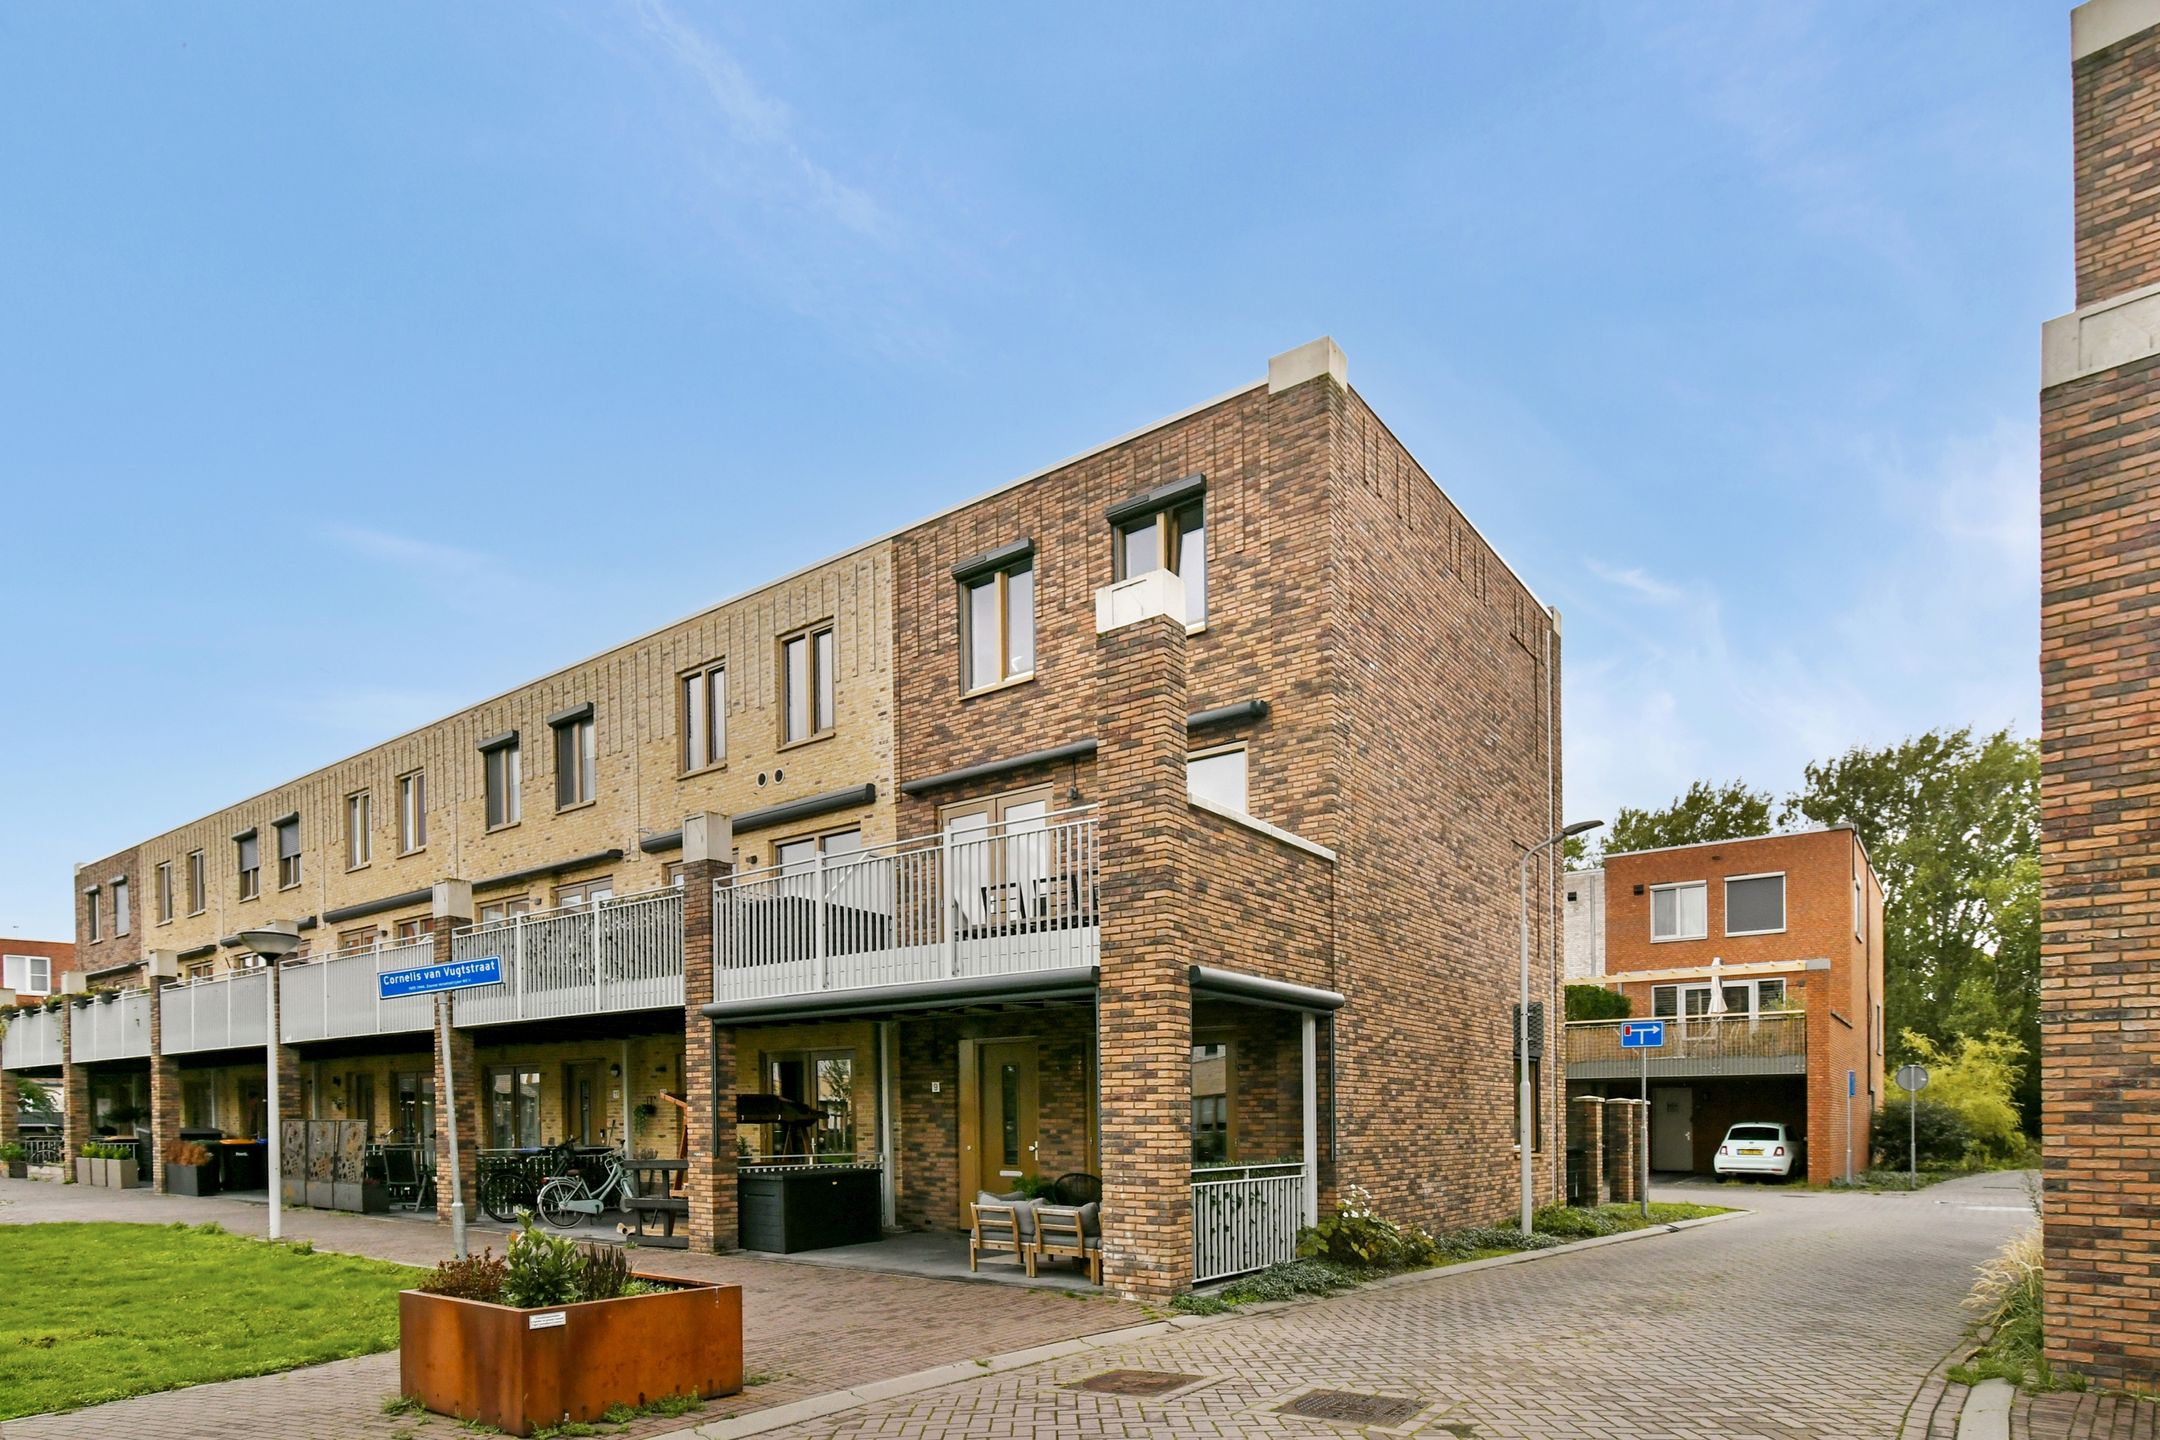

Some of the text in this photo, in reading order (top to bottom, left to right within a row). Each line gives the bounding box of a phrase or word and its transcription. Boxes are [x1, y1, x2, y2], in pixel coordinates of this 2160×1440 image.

[383, 971, 421, 985] Cornelis
[424, 970, 440, 979] van
[443, 961, 495, 977] Vugtstraat
